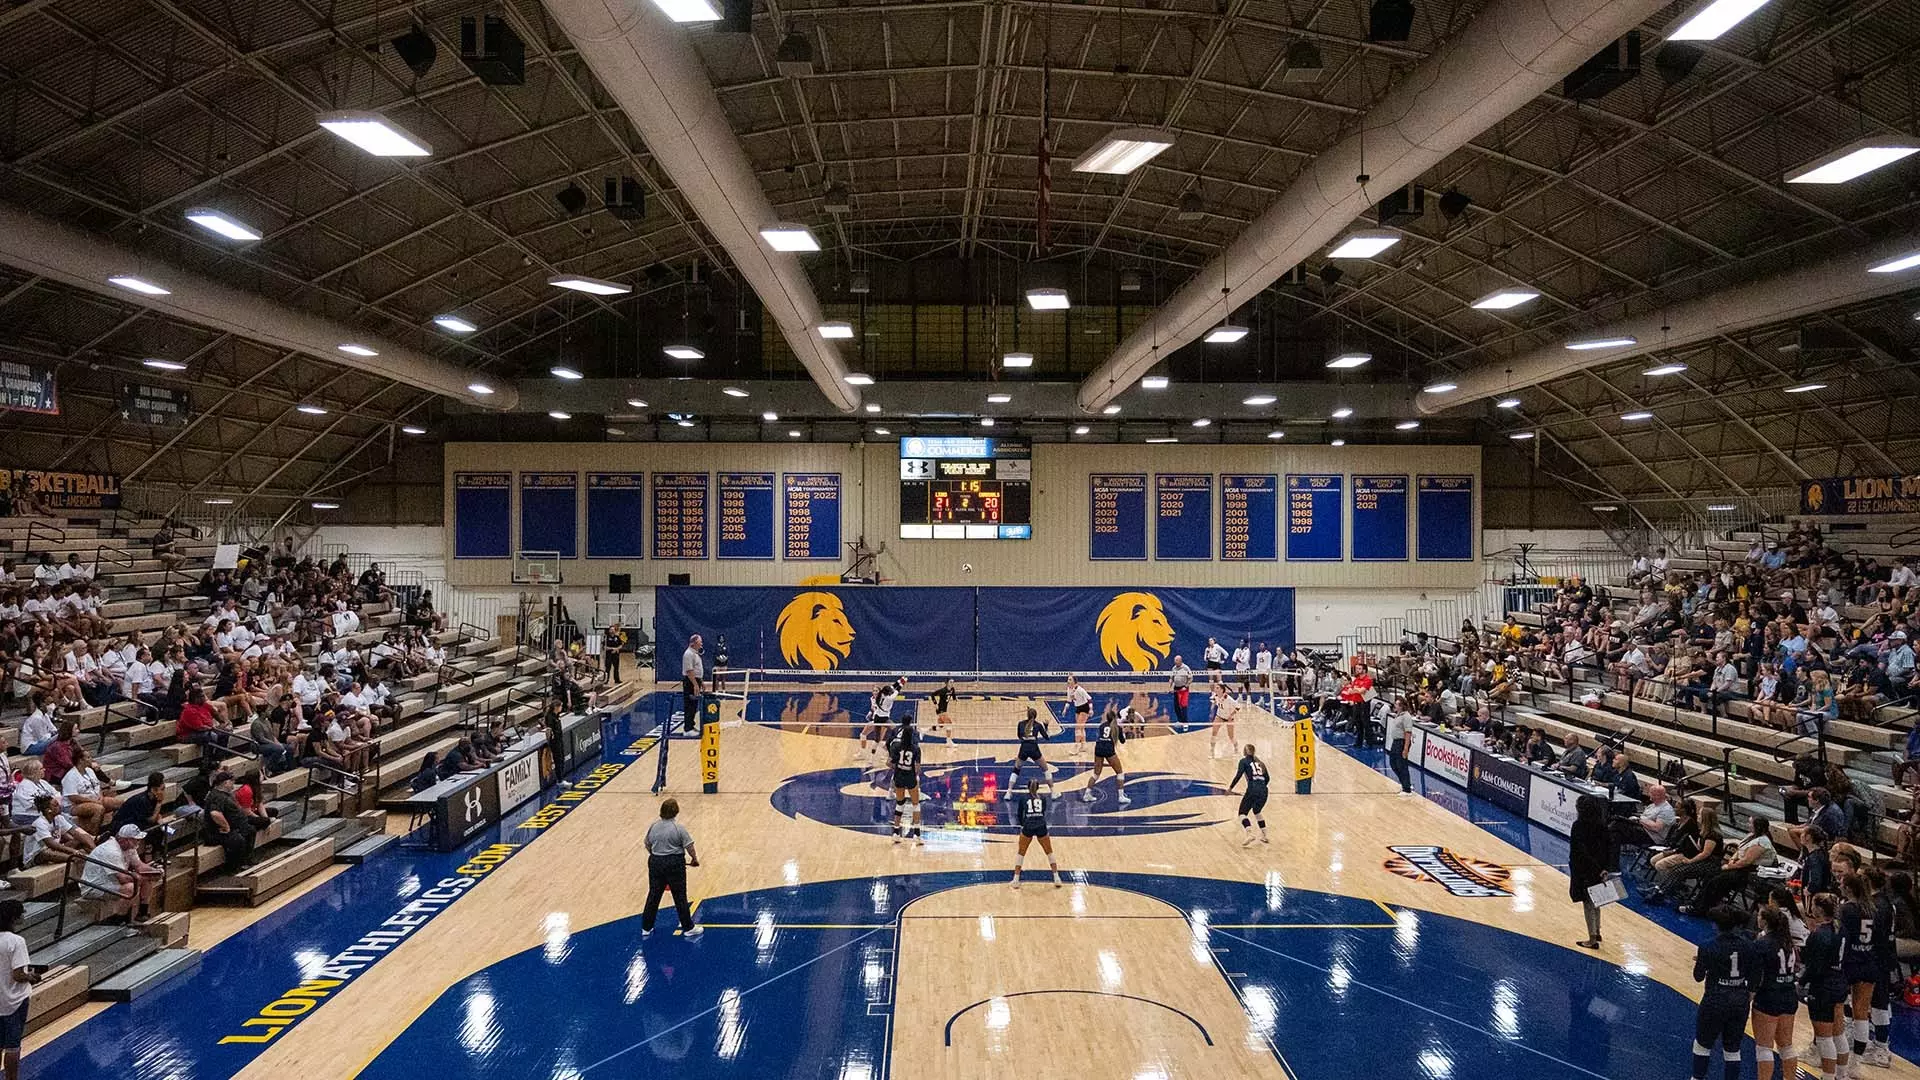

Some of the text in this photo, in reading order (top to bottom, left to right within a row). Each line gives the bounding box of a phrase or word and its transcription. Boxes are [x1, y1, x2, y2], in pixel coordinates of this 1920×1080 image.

[6, 378, 42, 393] CHAMPIONS
[20, 394, 36, 408] 1972
[927, 447, 986, 455] COMMERCE
[0, 470, 118, 494] BSKETBALL
[961, 481, 980, 492] 1:15
[1844, 478, 1893, 499] LION
[936, 498, 949, 508] 21
[962, 499, 968, 507] 2
[985, 498, 998, 508] 20
[1103, 727, 1111, 738] 9
[707, 726, 717, 780] LIONS
[1300, 723, 1309, 776] LIONS
[898, 750, 914, 766] 13
[1250, 762, 1262, 775] 15
[516, 803, 572, 829] BEST
[555, 791, 590, 801] IN
[574, 763, 625, 789] CLASS
[1026, 799, 1042, 813] 19
[1859, 920, 1873, 943] 5
[217, 842, 522, 1044] LIONATHLETICS.COM
[1730, 952, 1740, 977] 1
[1778, 948, 1796, 974] 14
